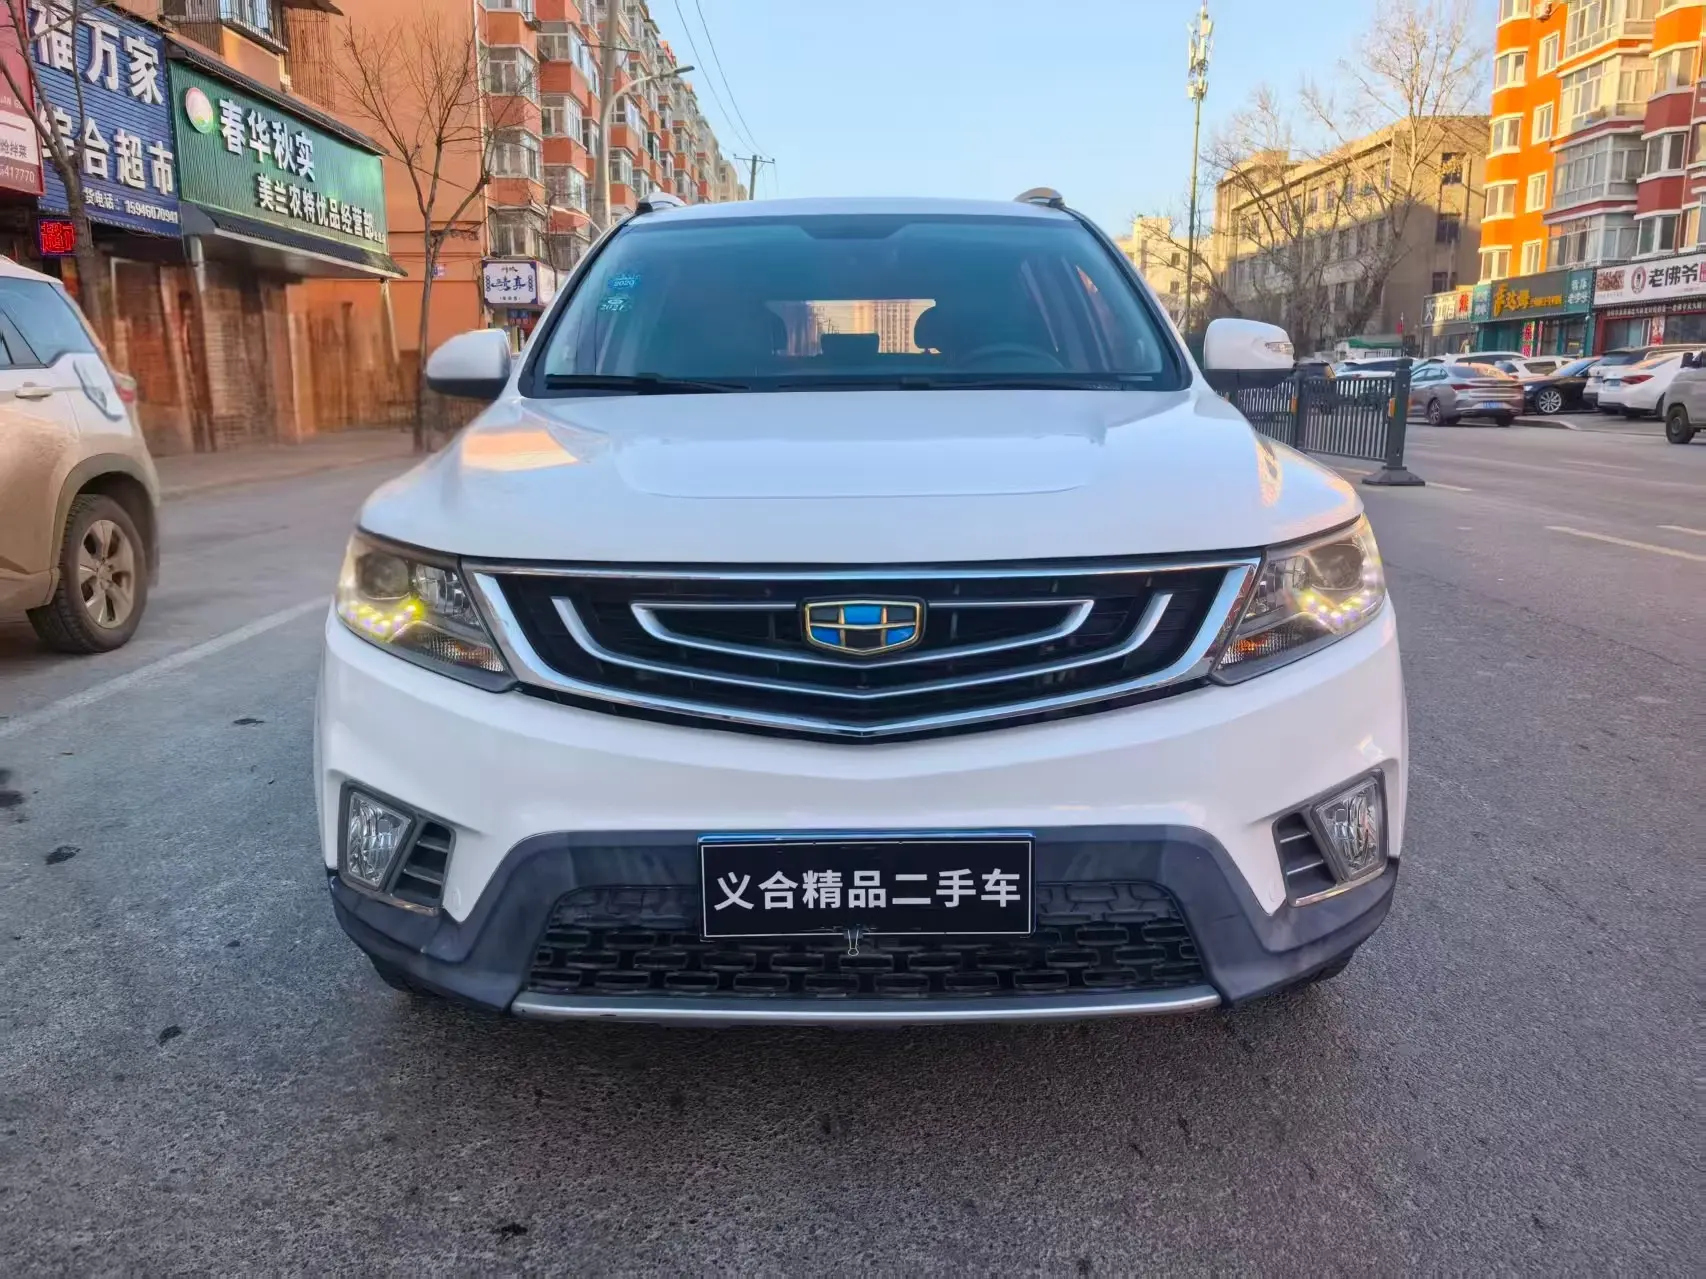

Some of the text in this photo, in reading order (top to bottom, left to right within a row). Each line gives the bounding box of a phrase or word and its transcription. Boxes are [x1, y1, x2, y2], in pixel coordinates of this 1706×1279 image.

[219, 98, 316, 181] 春华秋实
[1648, 262, 1699, 288] 老佛爷
[713, 868, 1021, 911] 义合精品二手车
